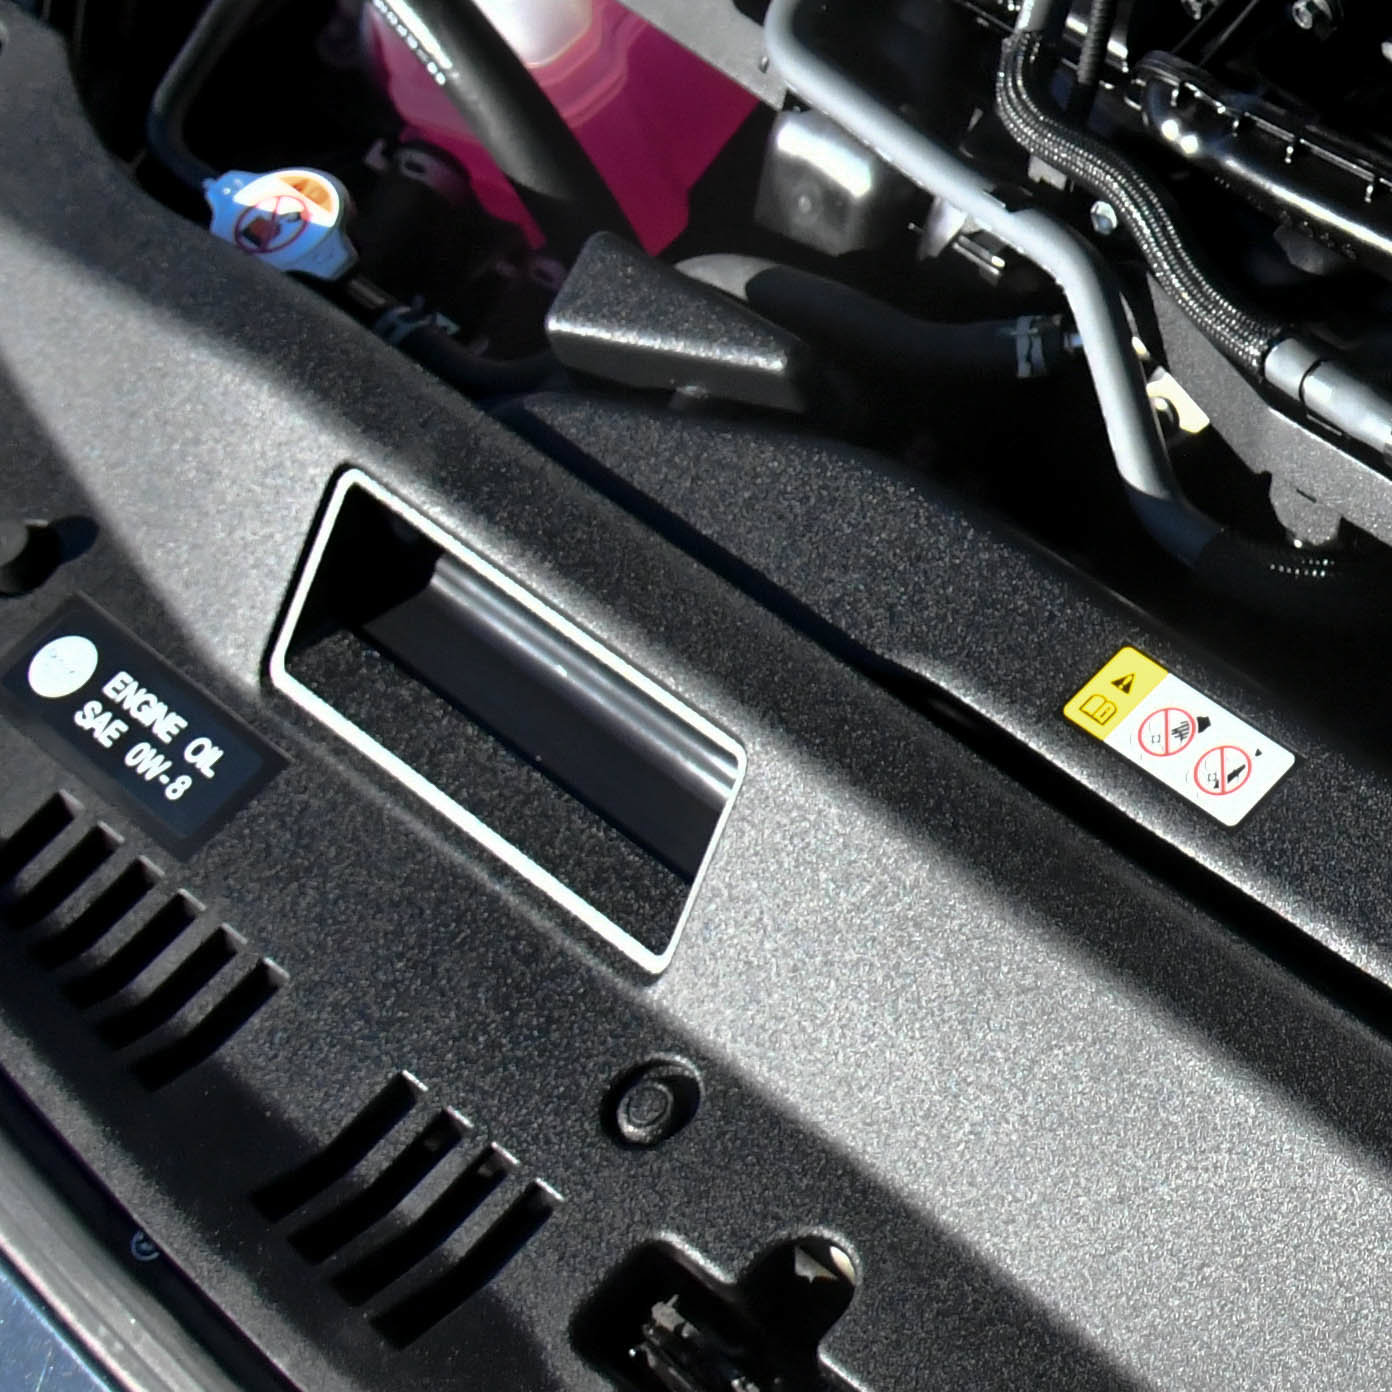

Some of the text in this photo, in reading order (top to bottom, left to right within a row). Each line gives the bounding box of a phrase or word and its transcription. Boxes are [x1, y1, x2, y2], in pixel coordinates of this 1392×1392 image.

[74, 700, 192, 800] SAE 0W-8
[101, 671, 224, 778] ENGINE OIL
